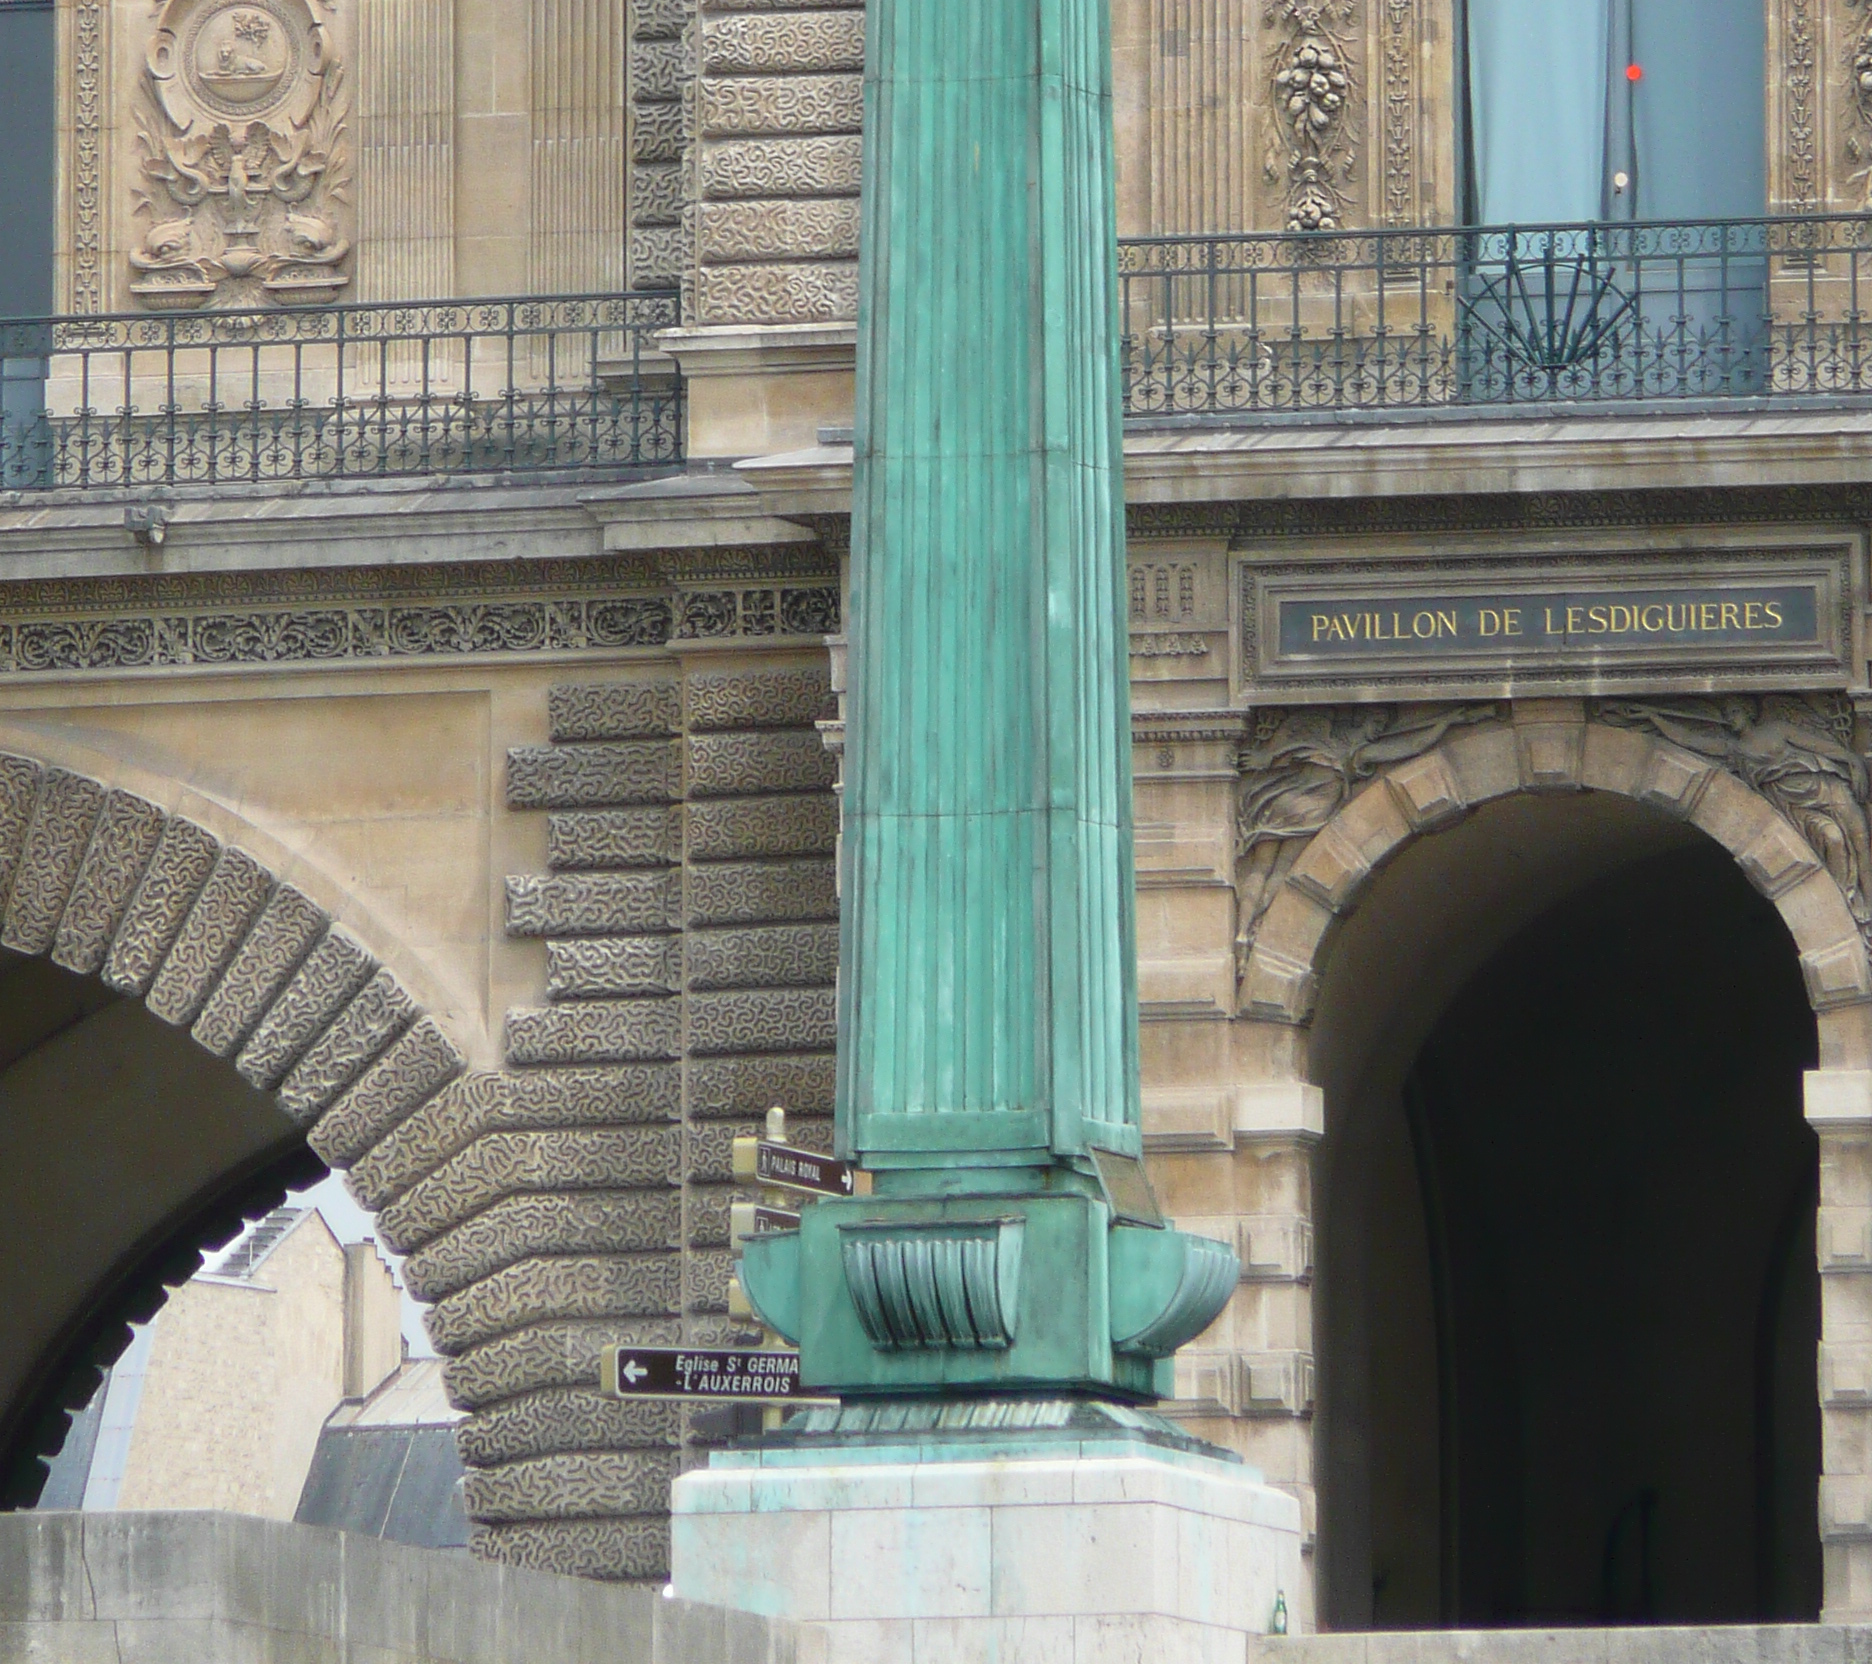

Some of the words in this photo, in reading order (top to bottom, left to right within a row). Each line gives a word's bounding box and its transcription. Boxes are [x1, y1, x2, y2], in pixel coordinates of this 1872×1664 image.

[1311, 610, 1458, 642] PAVILLON
[1479, 609, 1524, 637] DE
[1544, 601, 1784, 635] LESDIGUIERES
[771, 1155, 797, 1176] PALAIS
[798, 1161, 821, 1182] ROYAL
[675, 1355, 720, 1375] Eglise
[726, 1356, 742, 1373] St
